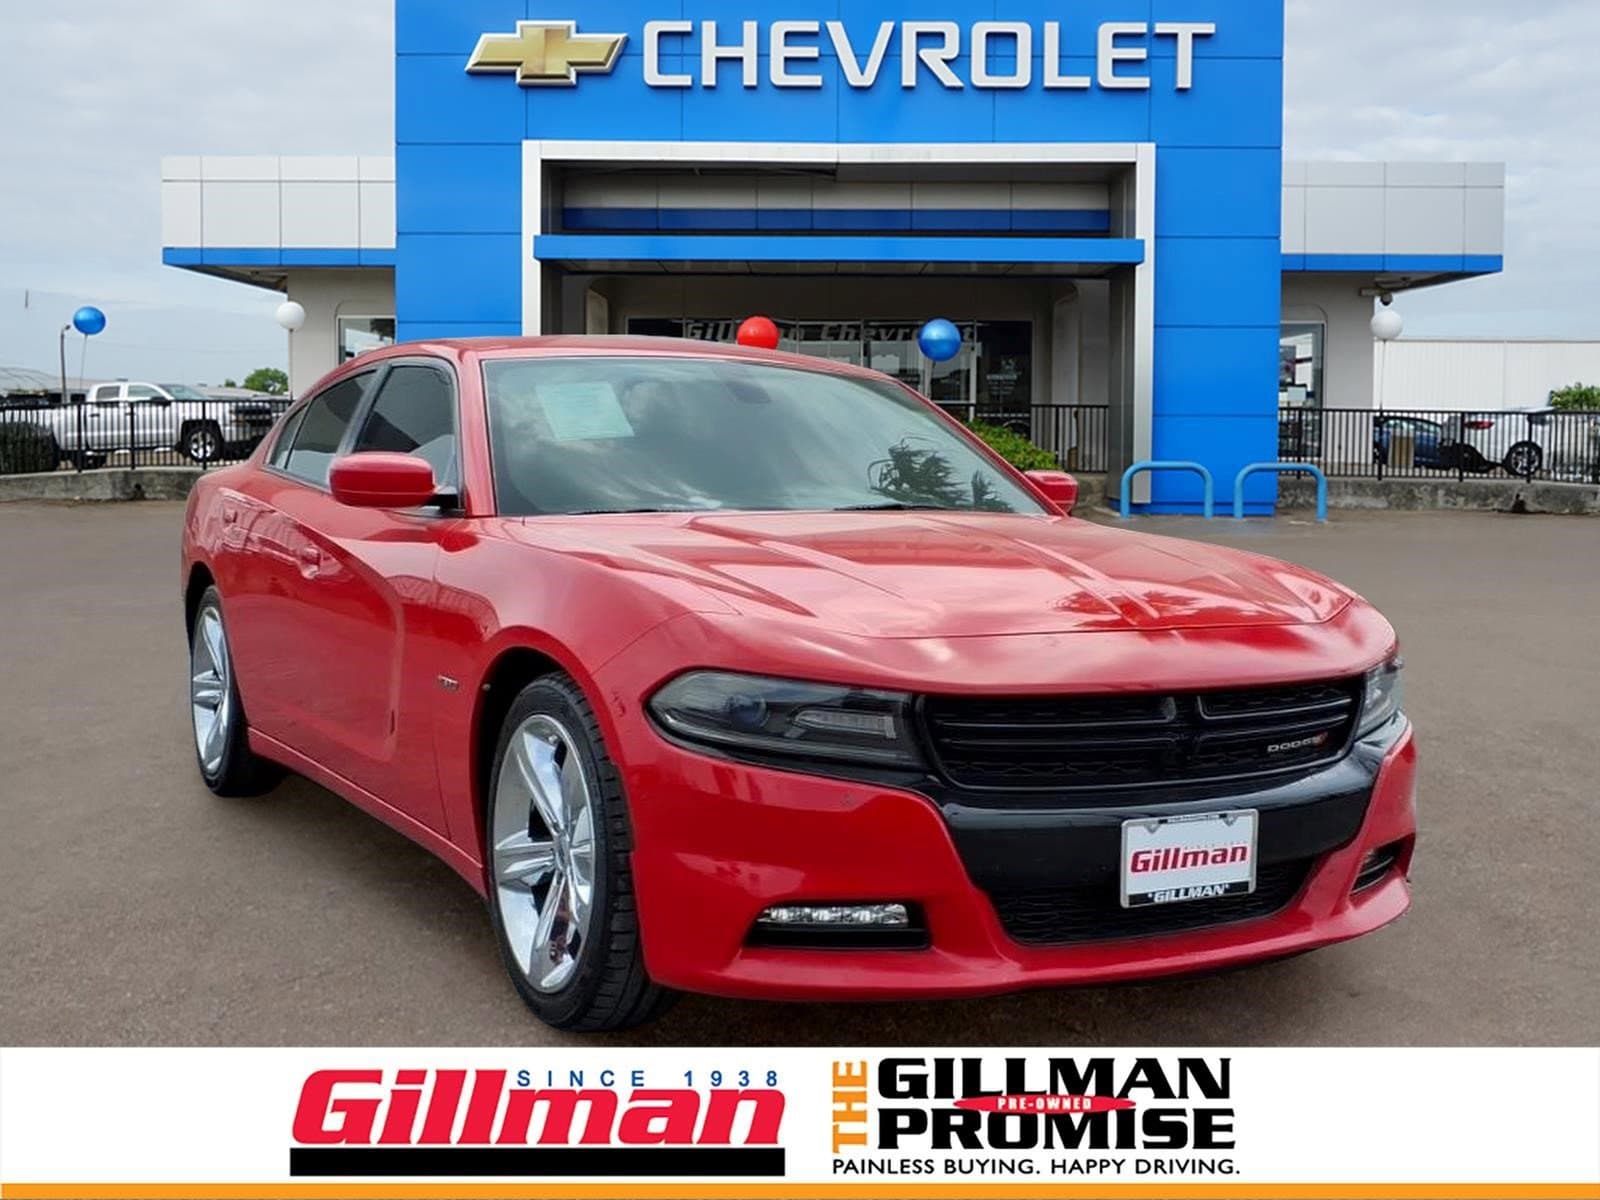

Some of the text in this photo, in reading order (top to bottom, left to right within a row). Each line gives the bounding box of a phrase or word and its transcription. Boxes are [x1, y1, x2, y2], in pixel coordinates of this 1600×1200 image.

[643, 20, 1216, 90] CHEVROLET
[688, 322, 973, 343] Gilln Chevrt
[1130, 846, 1248, 873] Gillman
